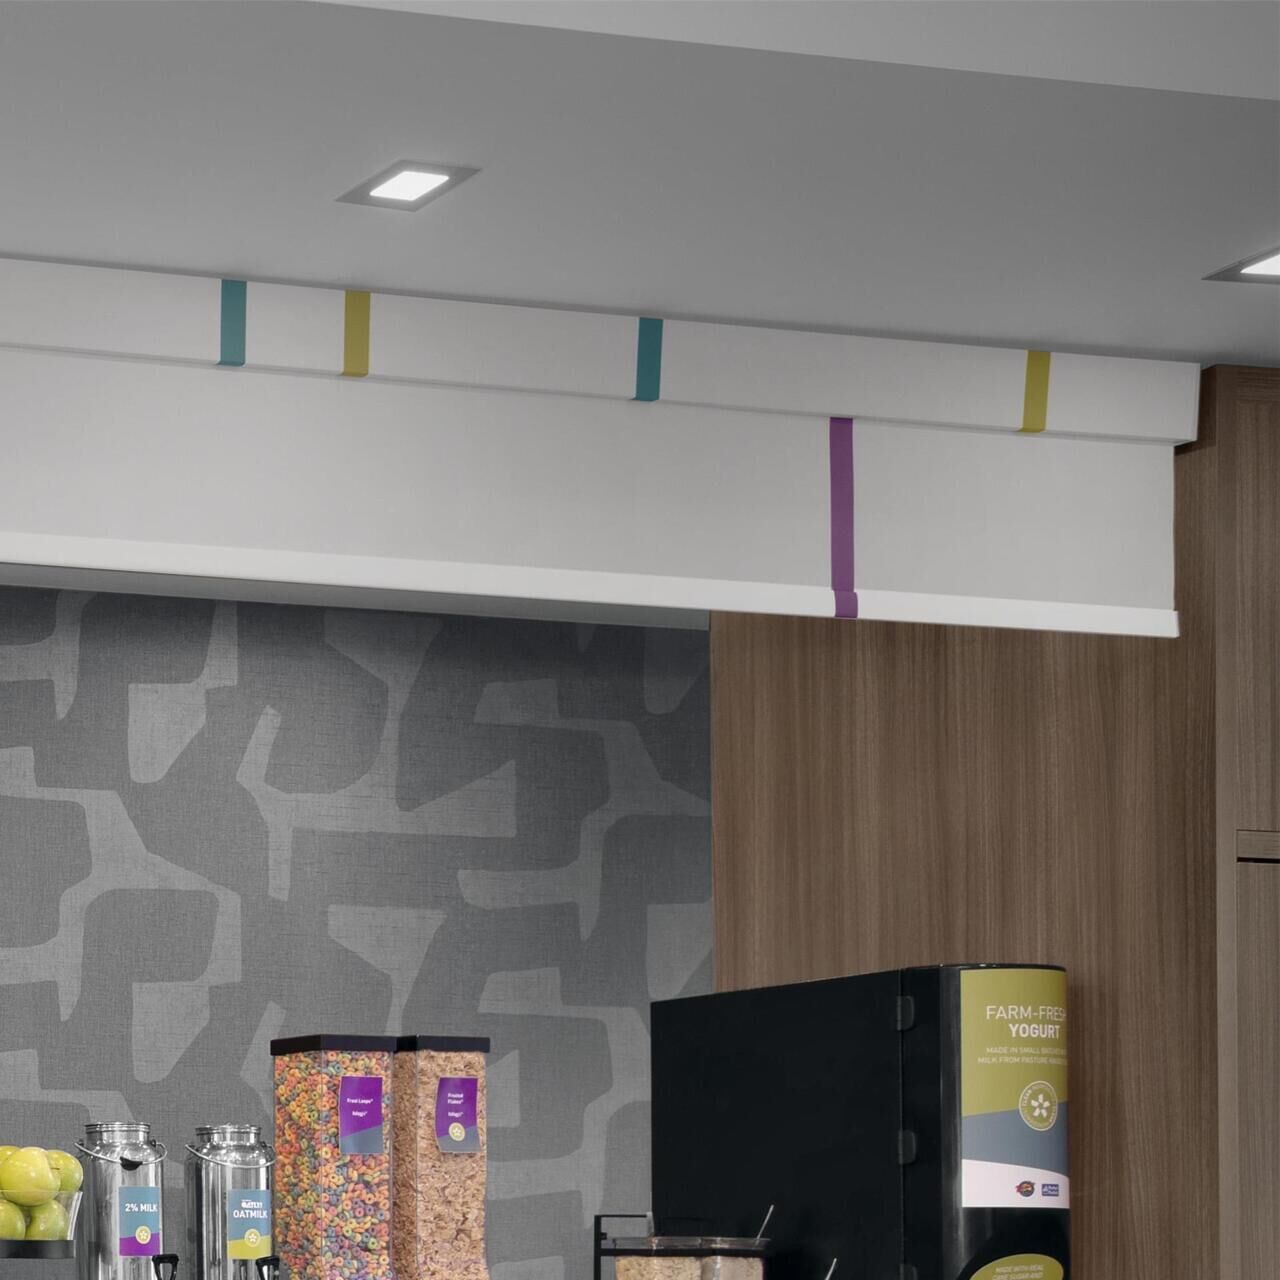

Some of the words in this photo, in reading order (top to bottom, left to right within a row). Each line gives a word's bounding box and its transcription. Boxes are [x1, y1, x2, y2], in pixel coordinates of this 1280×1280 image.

[1009, 1023, 1060, 1040] YOGURT
[1000, 1057, 1020, 1065] FROM
[125, 1203, 138, 1212] 2%
[140, 1203, 158, 1212] MILK
[233, 1209, 268, 1219] OATMILK
